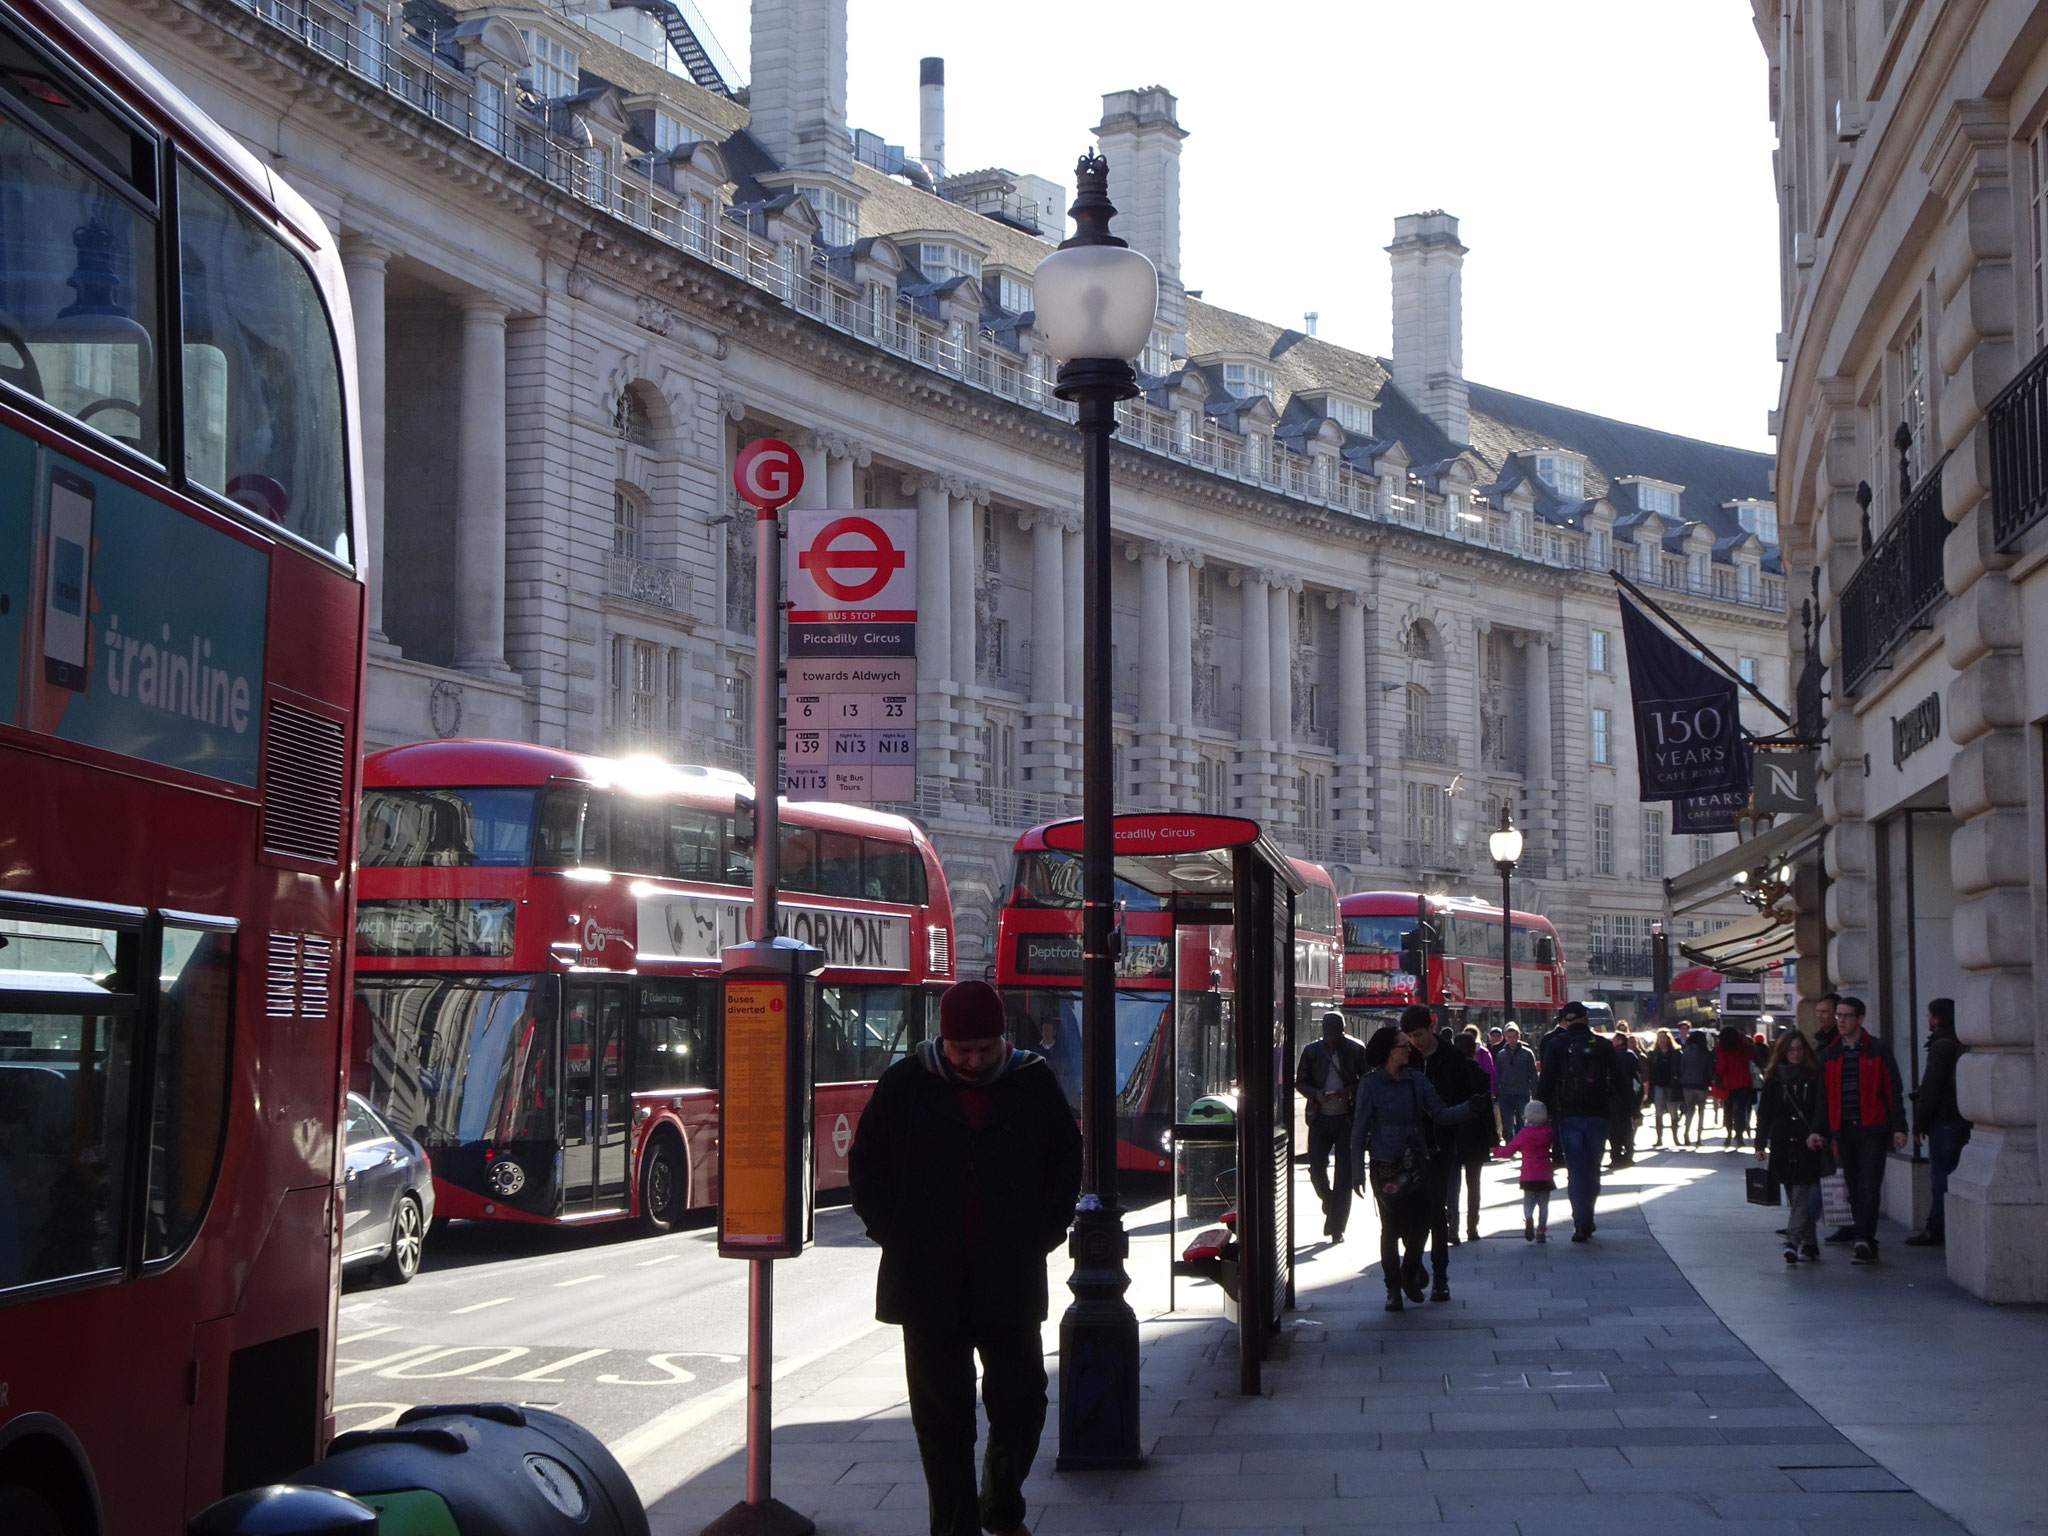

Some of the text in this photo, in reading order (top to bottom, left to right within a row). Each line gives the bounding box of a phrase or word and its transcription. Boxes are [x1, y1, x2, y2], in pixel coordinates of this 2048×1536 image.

[746, 450, 789, 499] G
[827, 612, 877, 620] BUS STOP
[803, 633, 901, 645] Piccadilly Circus
[105, 614, 249, 734] trainline
[802, 671, 901, 682] towards Aldwych
[803, 704, 812, 717] 6
[843, 704, 858, 717] 13
[885, 704, 903, 717] 23
[1651, 707, 1721, 745] 150
[795, 740, 819, 753] 139
[835, 740, 866, 753] N13
[879, 740, 909, 753] N18
[1655, 745, 1725, 767] YEARS
[787, 776, 827, 789] N113
[836, 774, 864, 783] Big Bus
[1764, 763, 1806, 802] N
[840, 783, 861, 791] Tours
[1688, 792, 1743, 807] YEARS
[1114, 828, 1195, 840] ccadilly Circus
[356, 915, 439, 938] wich Library
[1028, 944, 1080, 960] Deptford
[1395, 974, 1416, 991] 159
[727, 995, 754, 1004] Buses
[727, 1006, 766, 1014] diverted
